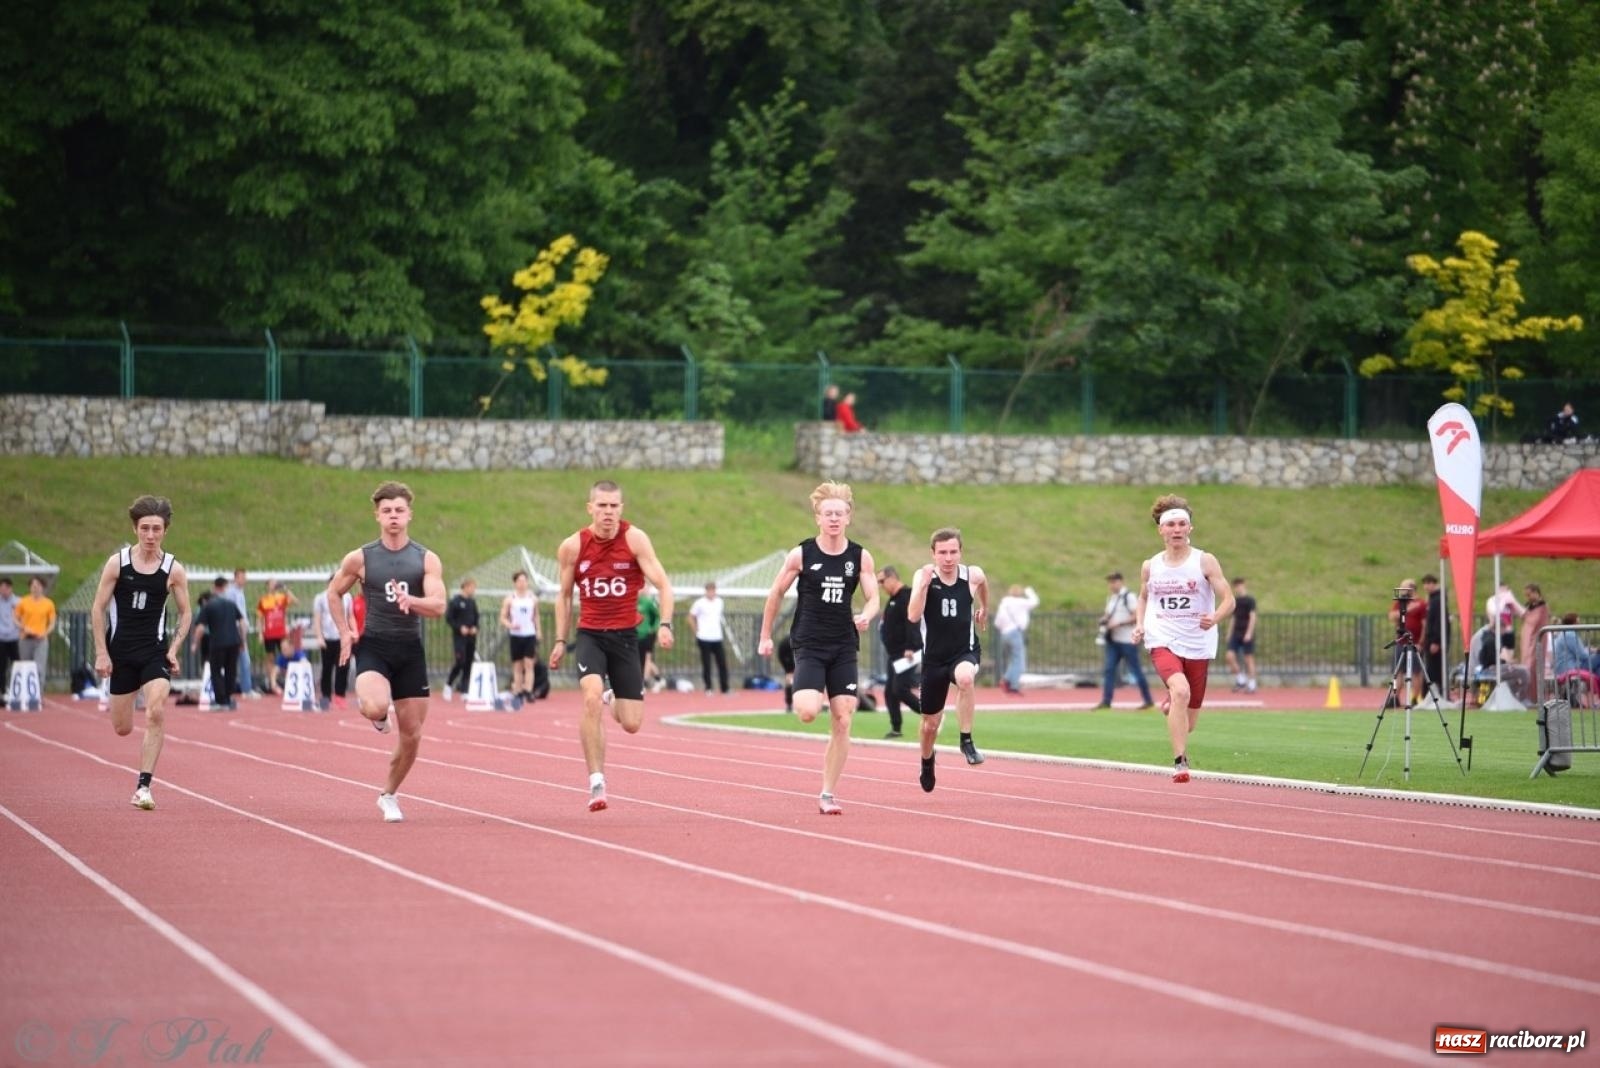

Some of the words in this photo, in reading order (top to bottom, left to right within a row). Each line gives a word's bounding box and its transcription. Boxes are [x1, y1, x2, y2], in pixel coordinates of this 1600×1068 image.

[580, 576, 627, 597] 156
[821, 588, 843, 603] 412
[1160, 597, 1191, 609] 152
